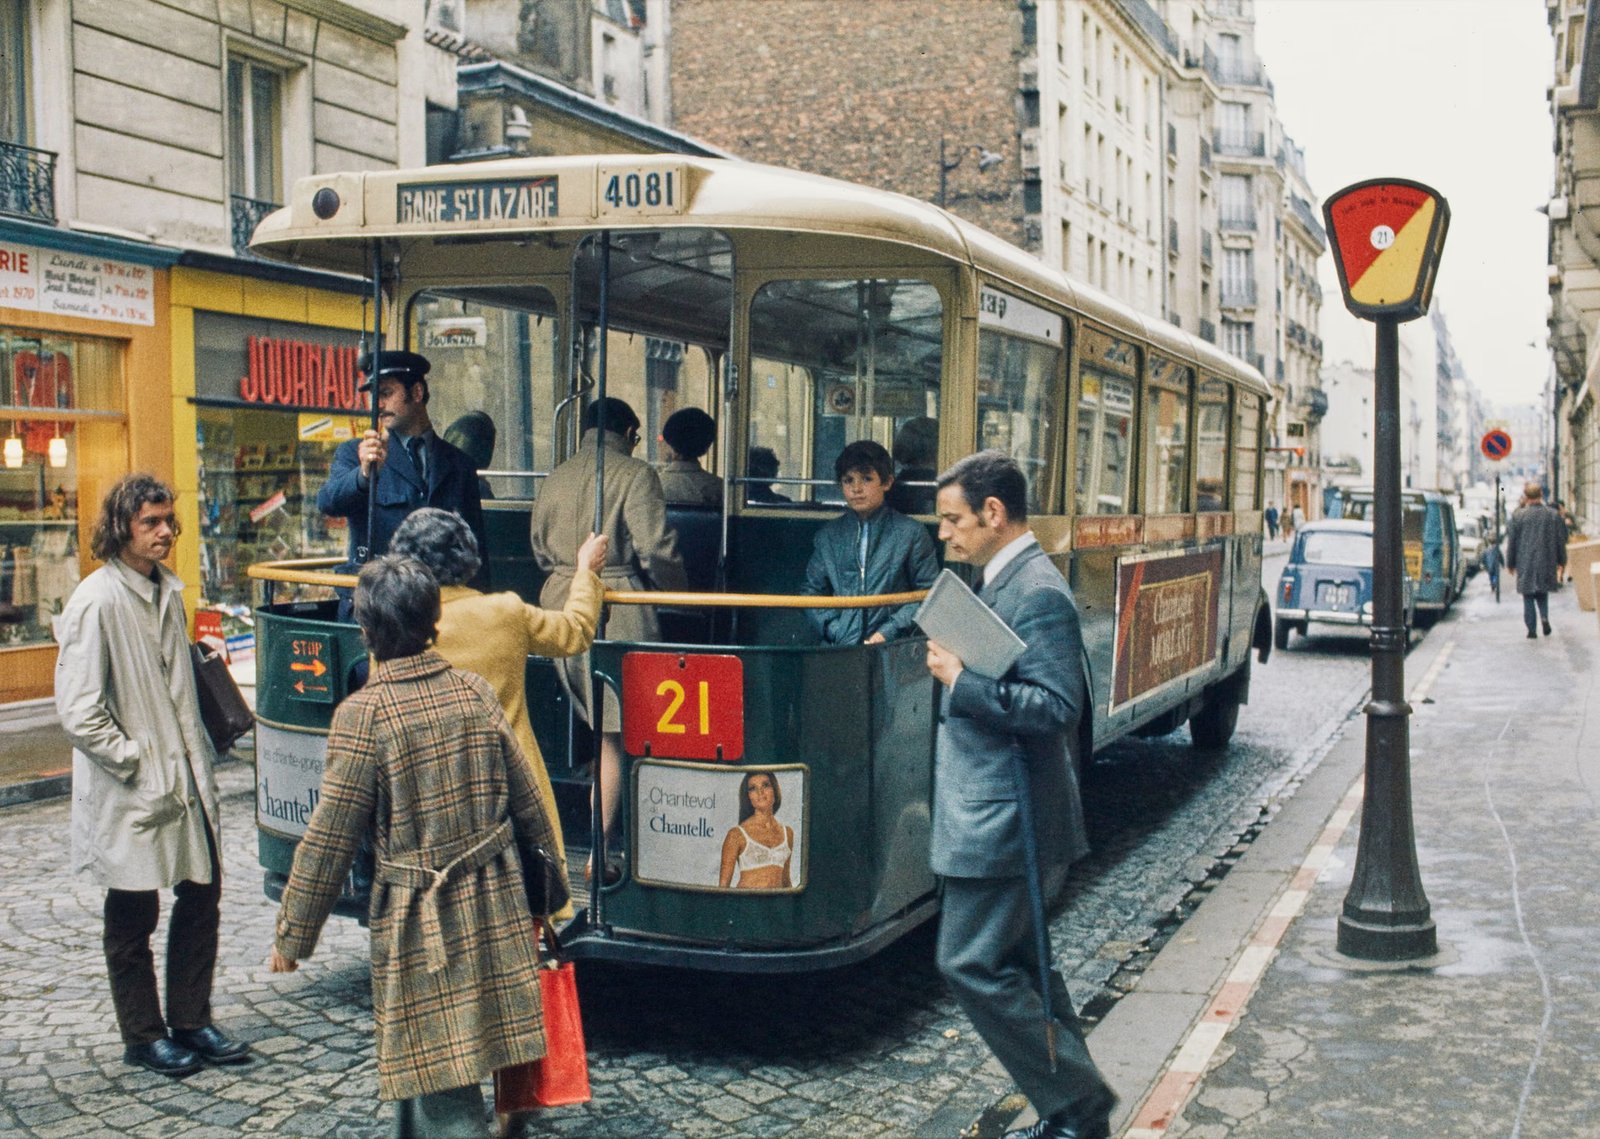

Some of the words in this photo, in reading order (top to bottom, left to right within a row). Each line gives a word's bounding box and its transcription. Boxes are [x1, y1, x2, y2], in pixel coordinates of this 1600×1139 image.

[605, 172, 673, 208] 4081
[401, 190, 446, 224] GARE
[478, 185, 555, 222] LAZARE
[1378, 231, 1388, 244] 21
[0, 249, 29, 274] RIE
[50, 254, 87, 271] Lundi
[240, 335, 372, 411] JOURNAUX
[292, 640, 323, 657] STOP
[656, 679, 710, 735] 21
[649, 786, 716, 810] Chantevol
[649, 813, 715, 838] Chantelle
